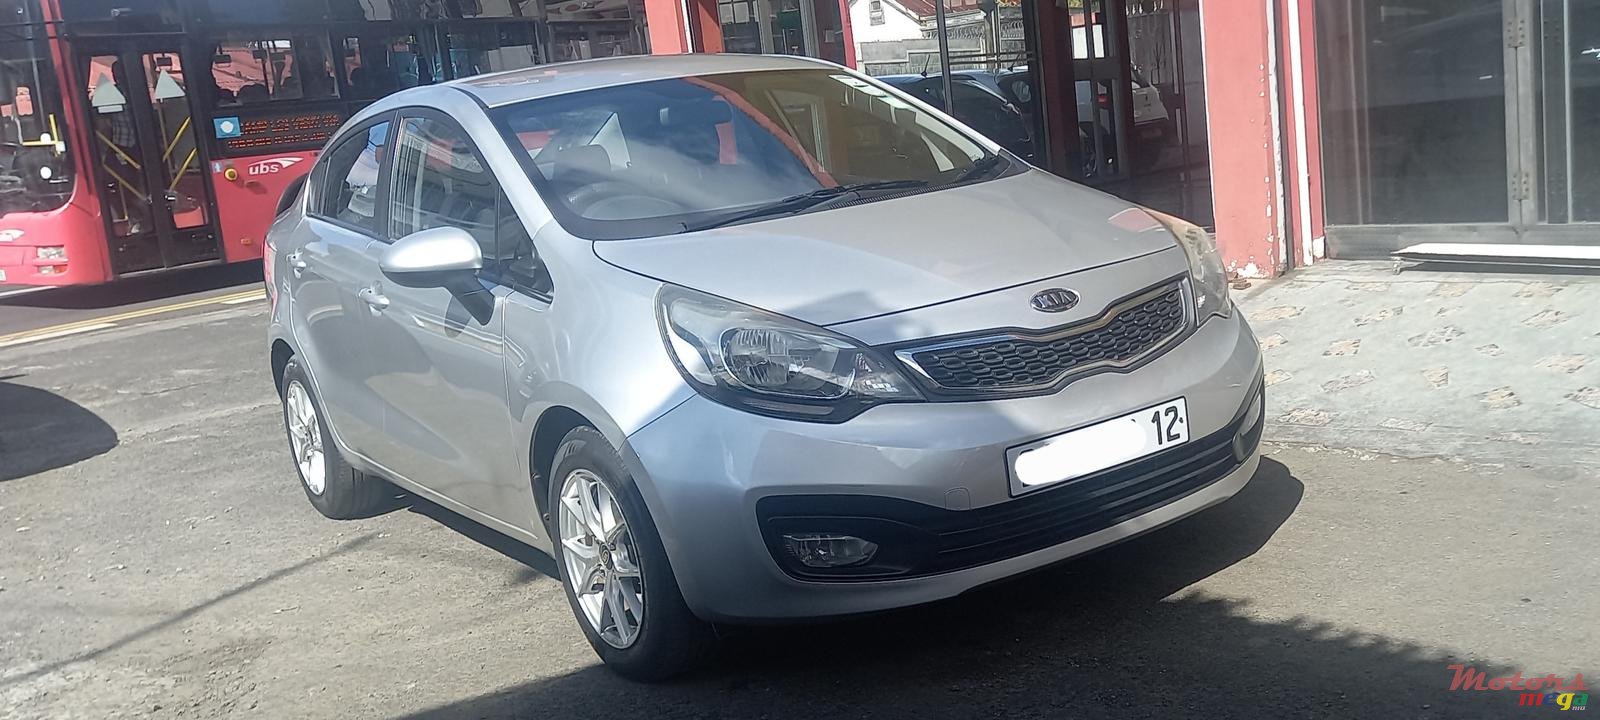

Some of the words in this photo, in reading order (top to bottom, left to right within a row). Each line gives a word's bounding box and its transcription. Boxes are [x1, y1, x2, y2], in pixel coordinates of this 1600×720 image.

[249, 161, 280, 175] ubs
[1036, 291, 1072, 308] KIA
[1151, 405, 1181, 446] 12
